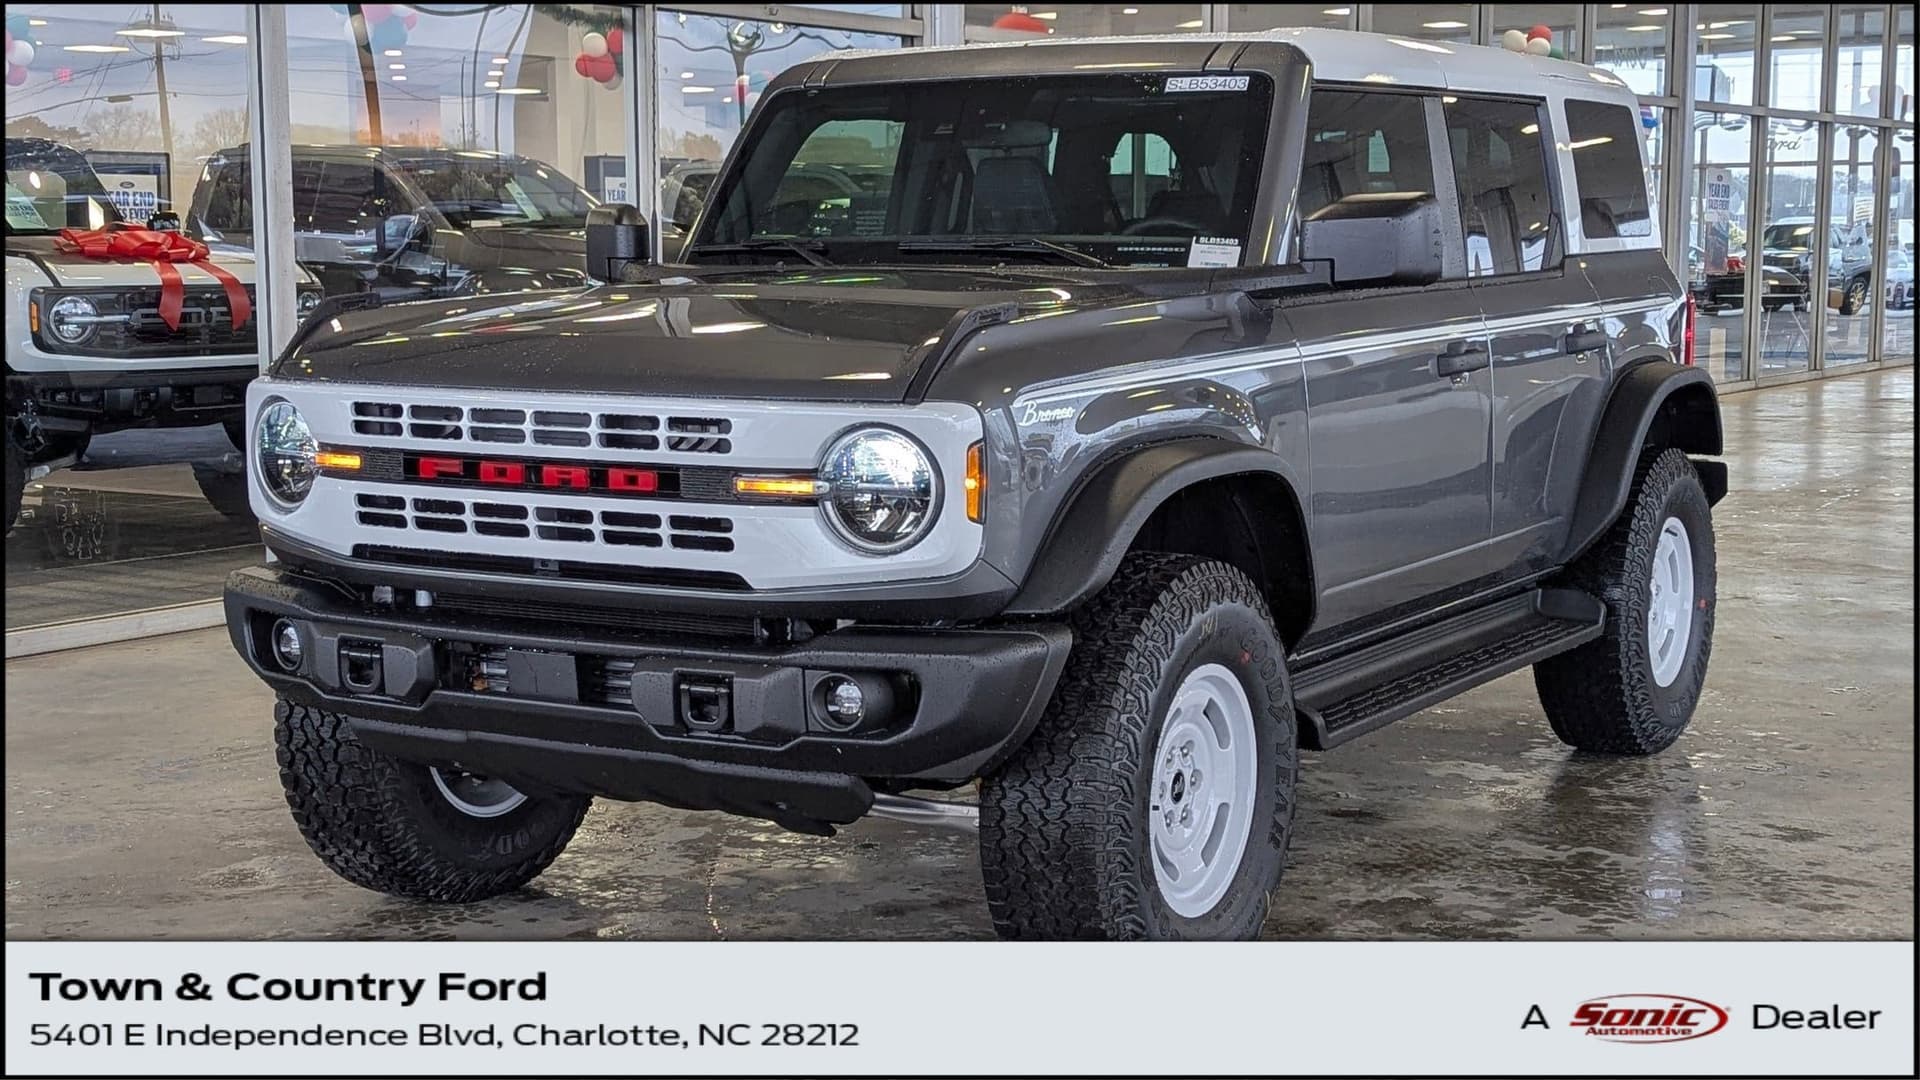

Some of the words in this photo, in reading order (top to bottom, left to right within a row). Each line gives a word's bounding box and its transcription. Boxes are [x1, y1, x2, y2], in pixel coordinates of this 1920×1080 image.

[1167, 79, 1248, 91] SLB53403
[133, 191, 154, 207] END
[1018, 400, 1076, 427] Bronco
[418, 456, 658, 492] FORD
